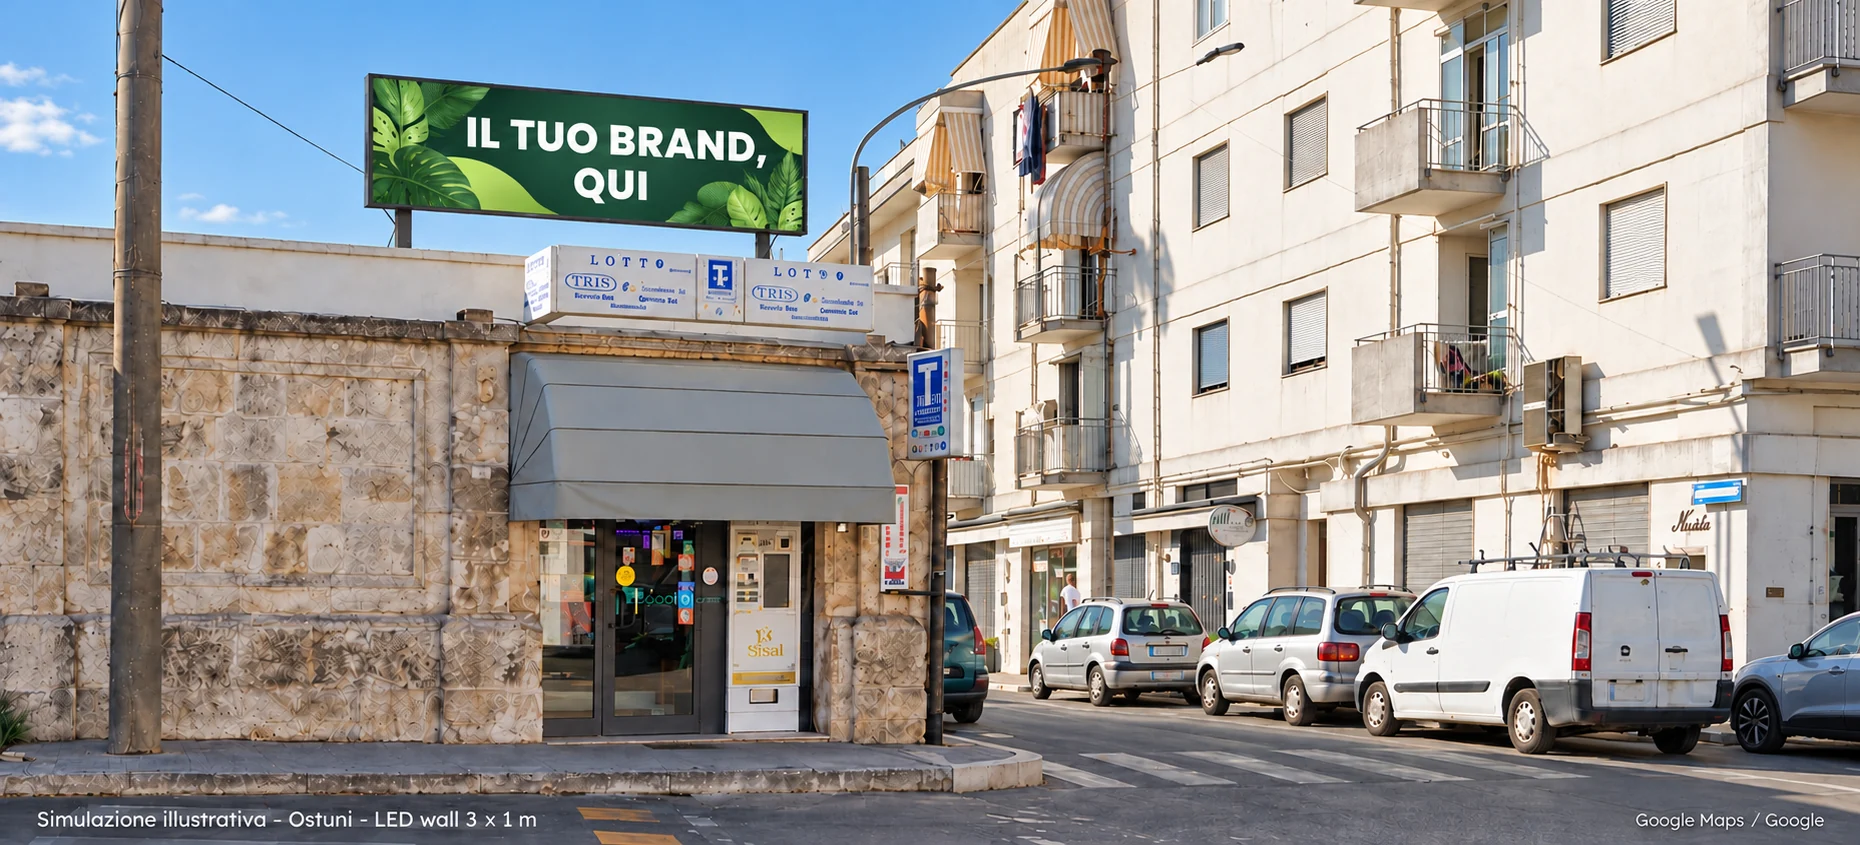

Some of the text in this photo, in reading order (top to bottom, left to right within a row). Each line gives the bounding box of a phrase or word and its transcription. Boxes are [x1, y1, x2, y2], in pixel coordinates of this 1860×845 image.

[467, 116, 767, 169] IL TUO BRAND,
[573, 167, 648, 204] QUI
[571, 274, 610, 289] TRIS
[757, 286, 793, 300] TRIS
[917, 361, 938, 407] T
[747, 643, 784, 657] Sisal
